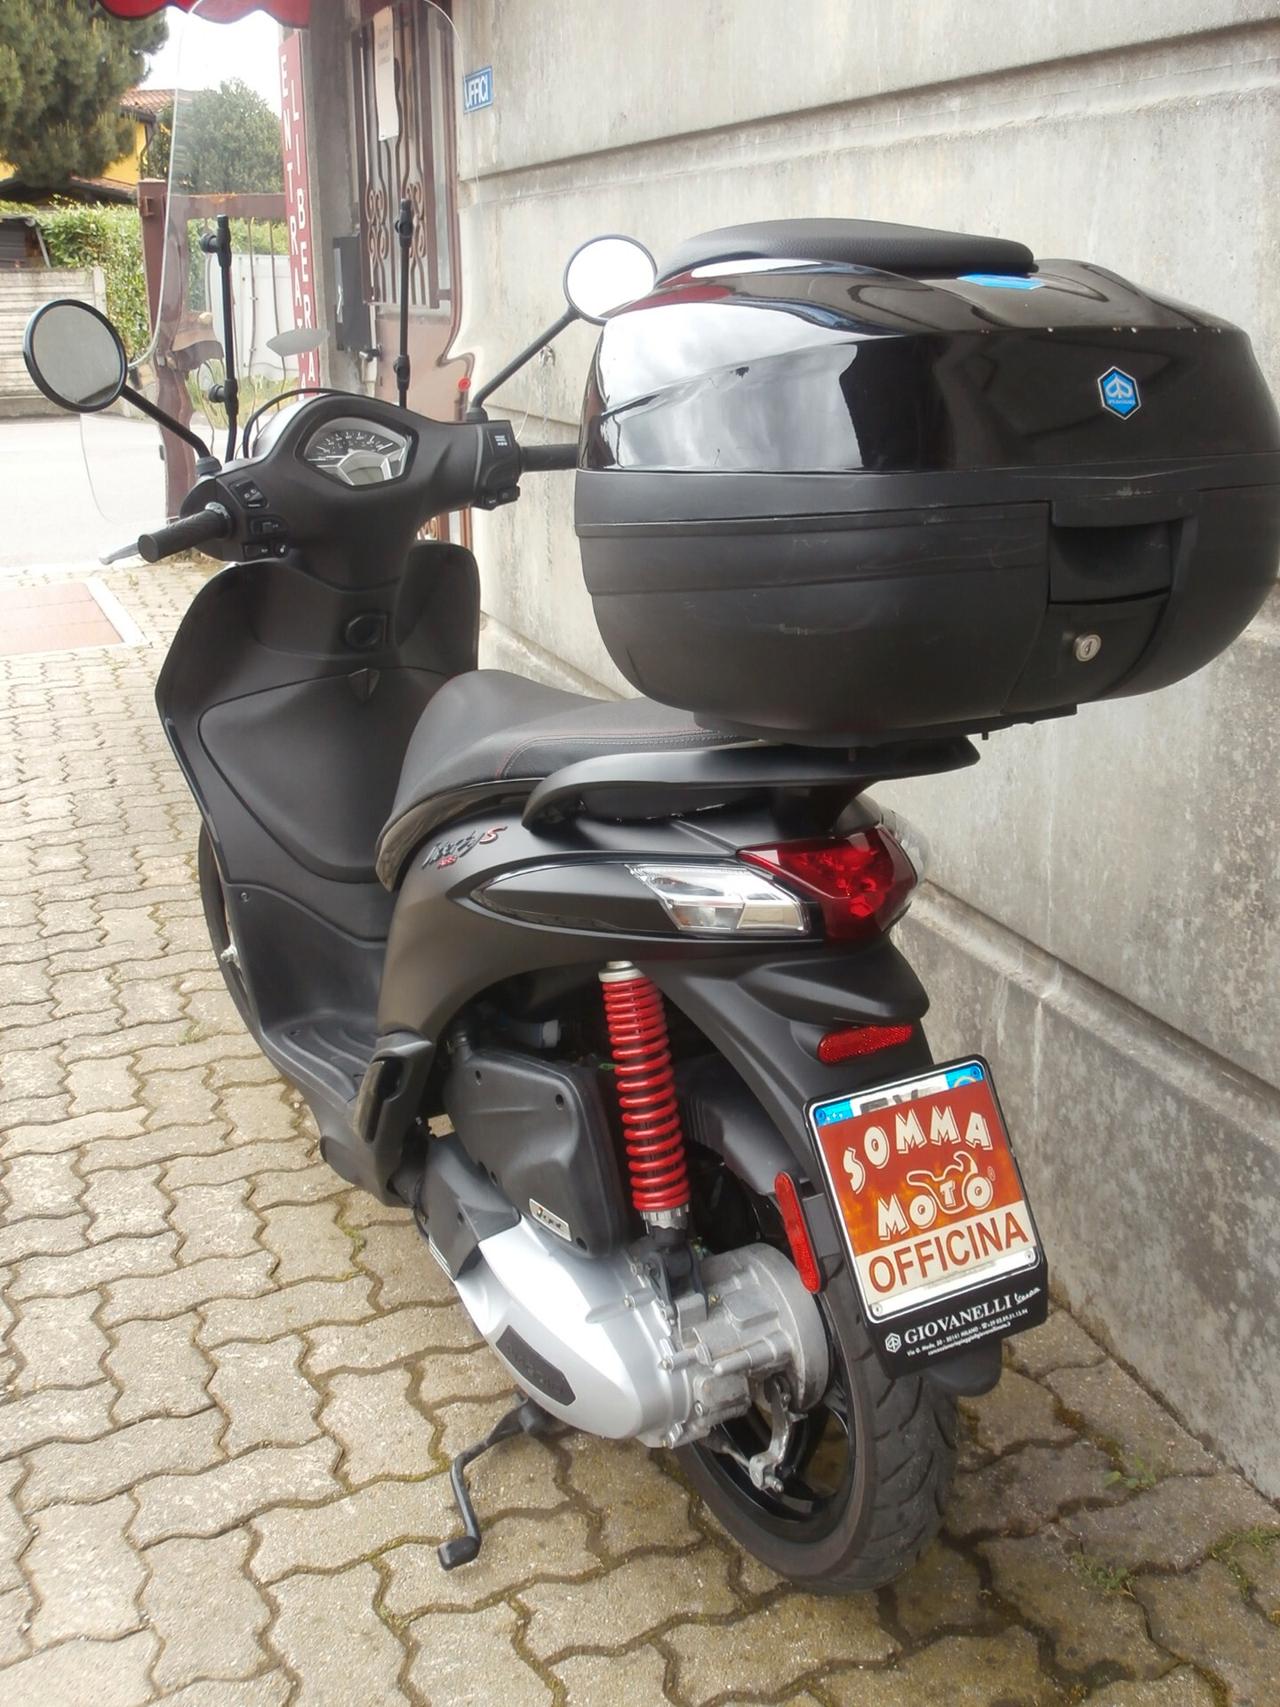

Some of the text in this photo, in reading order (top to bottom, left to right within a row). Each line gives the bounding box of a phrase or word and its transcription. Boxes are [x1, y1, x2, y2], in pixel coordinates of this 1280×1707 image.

[465, 74, 489, 108] UFFICI
[291, 79, 315, 382] LIBERA
[843, 1105, 993, 1194] SOMMA
[877, 1174, 993, 1241] MOTO
[868, 1211, 1029, 1294] OFFICINA
[904, 1294, 1013, 1345] GIOVANELLI
